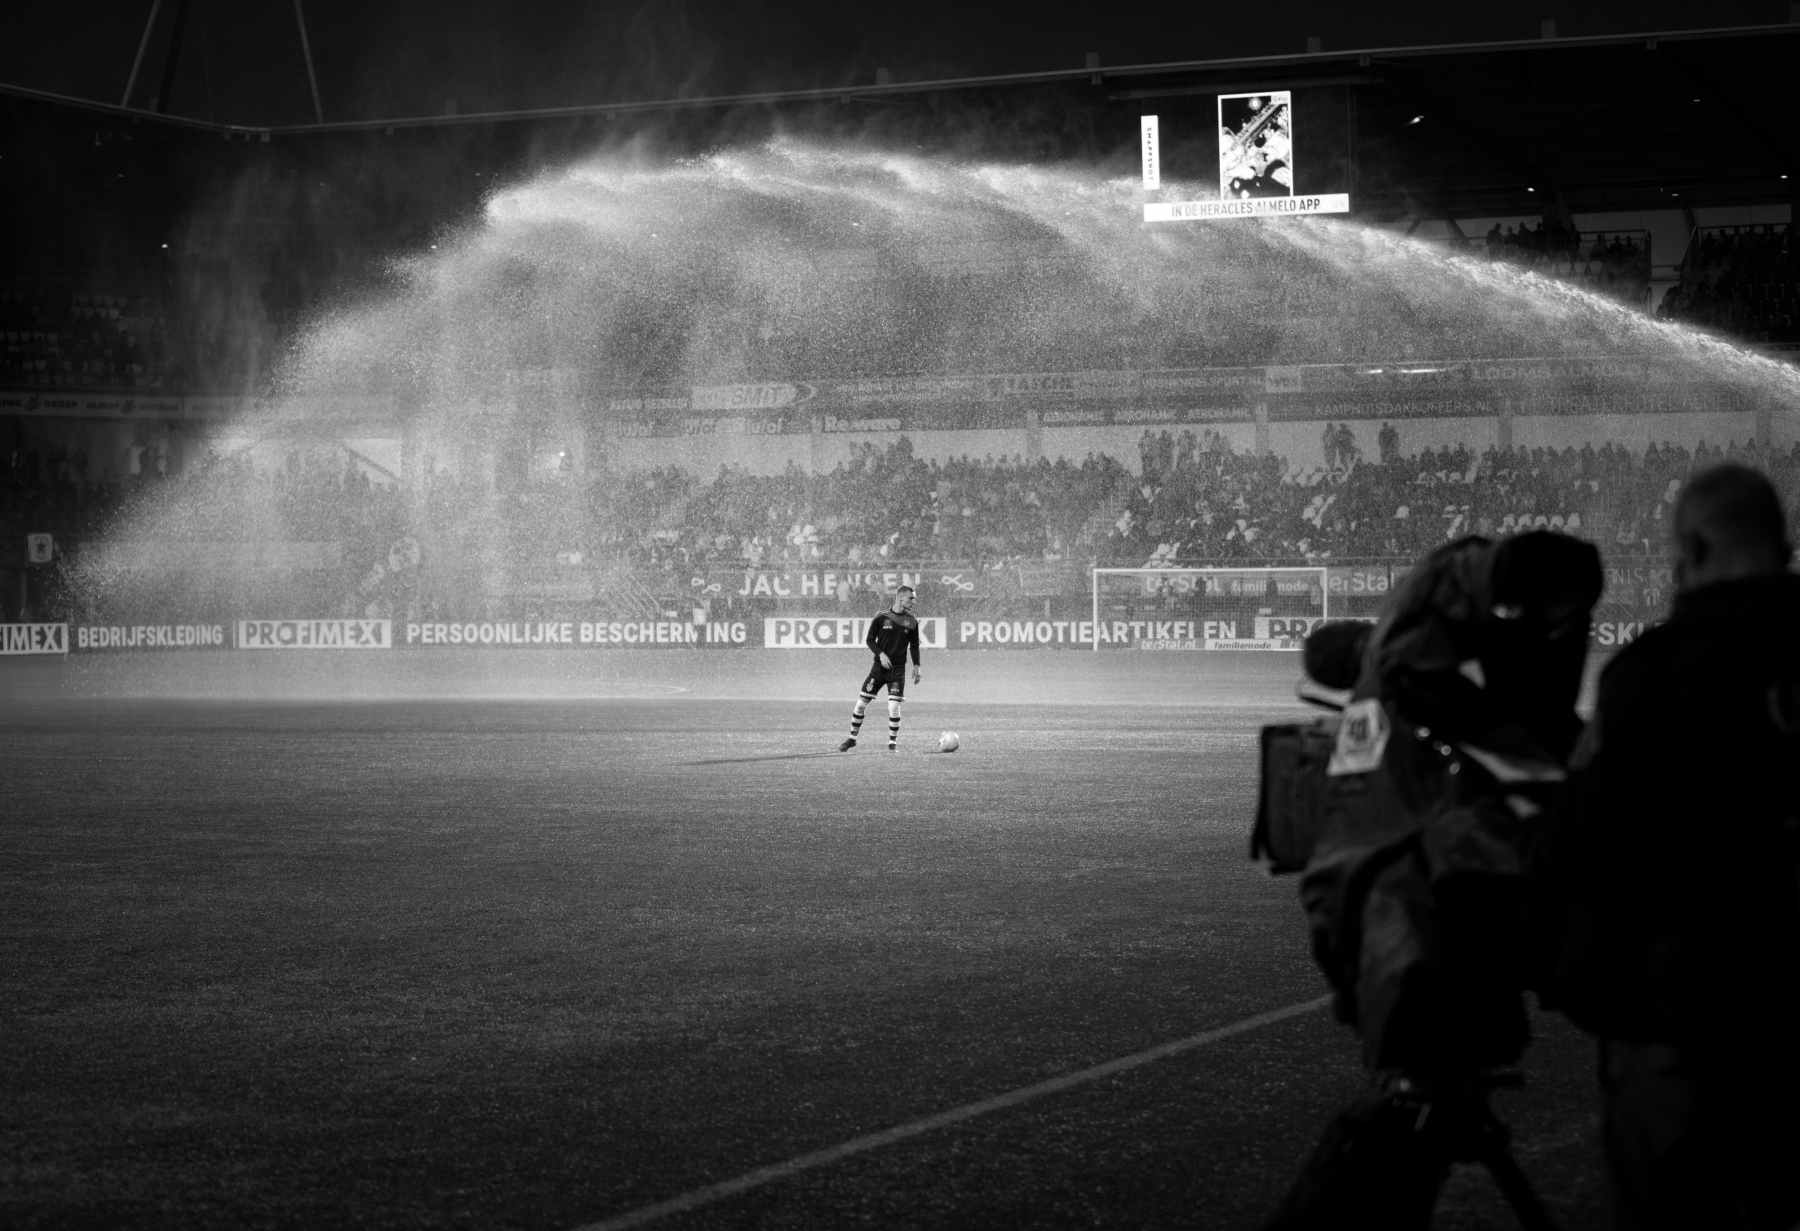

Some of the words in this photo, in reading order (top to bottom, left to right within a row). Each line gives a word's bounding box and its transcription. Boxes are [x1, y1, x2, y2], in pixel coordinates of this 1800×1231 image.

[1171, 203, 1182, 217] IN
[1185, 203, 1198, 216] DE
[1200, 201, 1253, 215] HERACLES
[1299, 198, 1321, 211] APP
[43, 400, 78, 409] GROEP
[86, 401, 120, 410] NIJHOF
[739, 574, 790, 596] JAC
[77, 624, 223, 649] BEDRIJFSKLEDING
[244, 621, 376, 648] PROFIMEX
[406, 622, 574, 644] PERSOONLIJKE
[1213, 640, 1272, 651] familiemode
